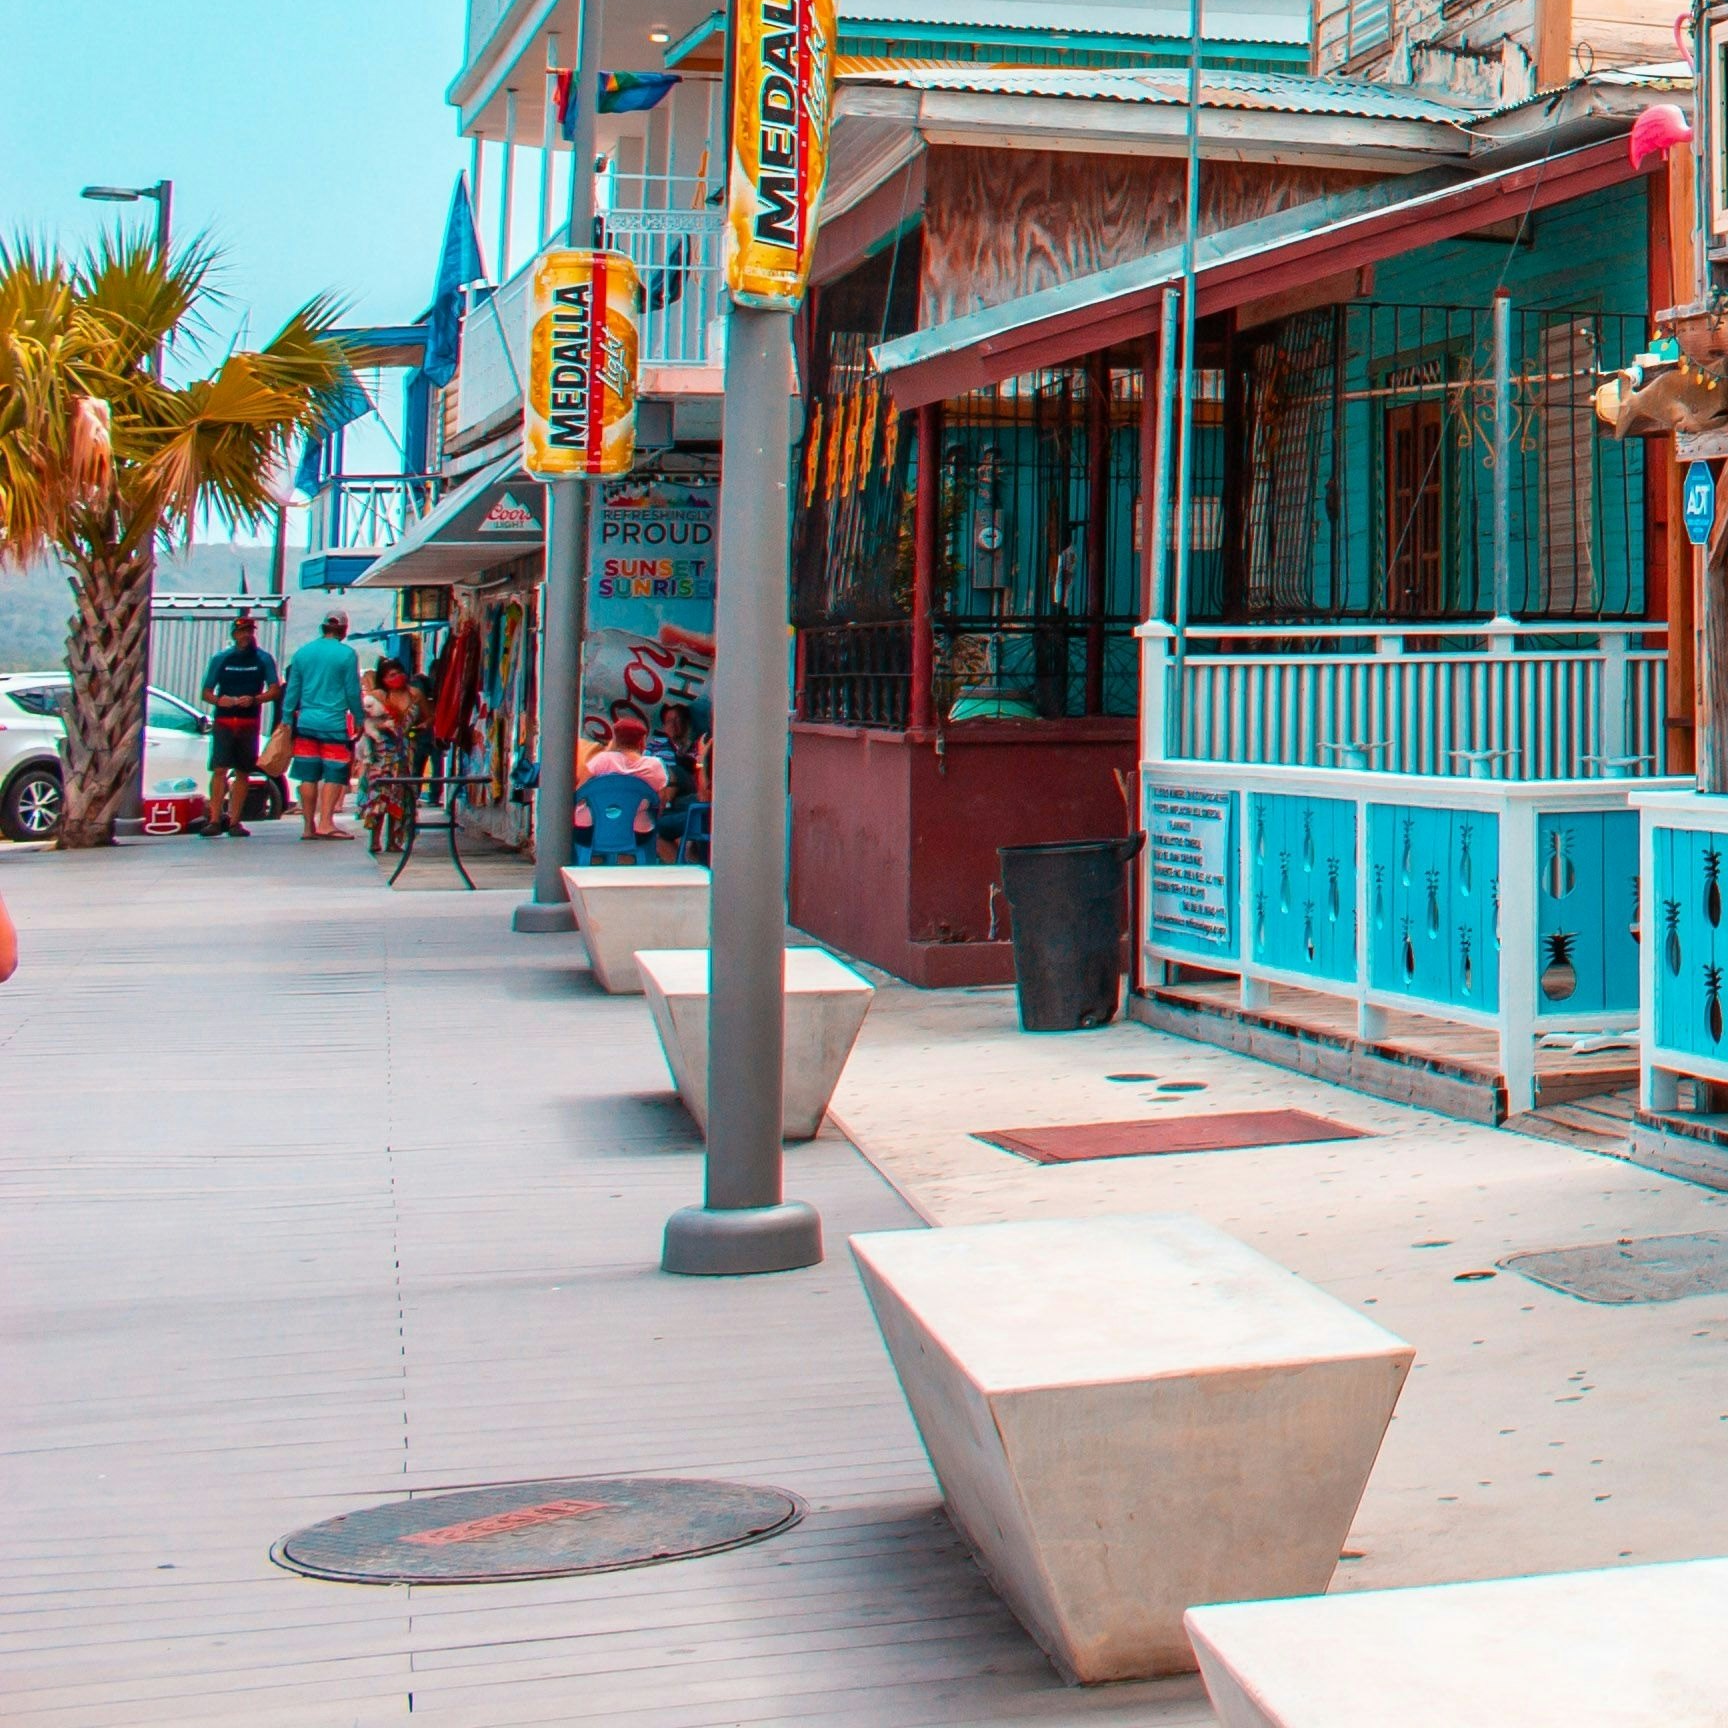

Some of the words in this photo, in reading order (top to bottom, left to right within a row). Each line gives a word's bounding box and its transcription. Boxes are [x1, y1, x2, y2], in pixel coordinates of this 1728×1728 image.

[802, 3, 830, 143] Light
[546, 281, 593, 449] MEDALLA
[594, 324, 630, 399] Light
[1686, 485, 1711, 515] ADT
[487, 503, 532, 524] Coors
[604, 509, 712, 521] REFRESHINGLY
[602, 522, 713, 544] PROUD
[605, 559, 706, 578] SUNSET
[599, 578, 711, 599] SUNRISE
